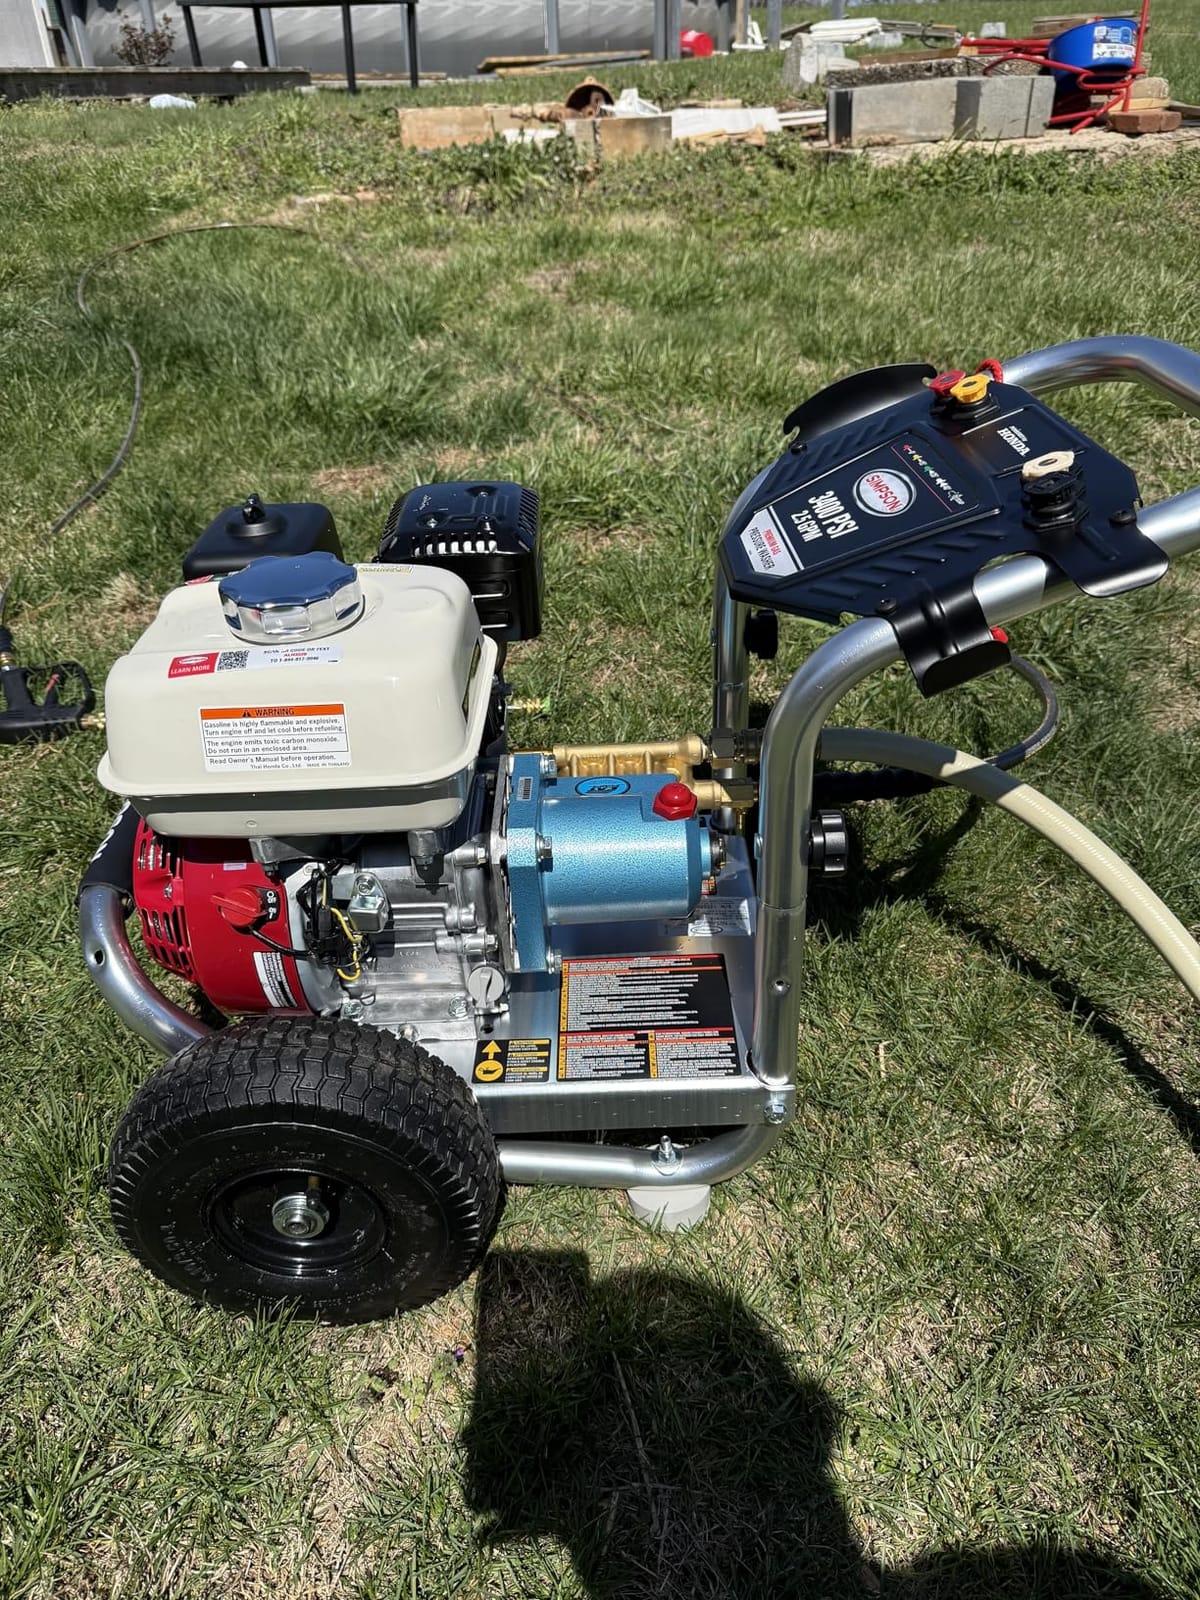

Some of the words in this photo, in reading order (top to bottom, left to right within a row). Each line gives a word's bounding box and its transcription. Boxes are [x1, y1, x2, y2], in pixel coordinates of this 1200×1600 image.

[996, 427, 1031, 457] HONDA
[865, 474, 903, 511] SIMPSON
[807, 490, 845, 519] 3400
[797, 520, 823, 542] GPM
[821, 512, 859, 539] PSI
[748, 527, 767, 551] PRESSURE
[757, 548, 776, 570] WASHER
[170, 667, 191, 675] LEARN
[191, 664, 210, 672] MORE
[239, 719, 259, 728] highly
[260, 718, 294, 726] flammable
[308, 717, 341, 725] explosive.
[255, 708, 295, 717] WARNING
[220, 728, 242, 736] engine
[220, 739, 243, 747] engine
[306, 735, 341, 743] monoxide.
[303, 754, 337, 762] operation.
